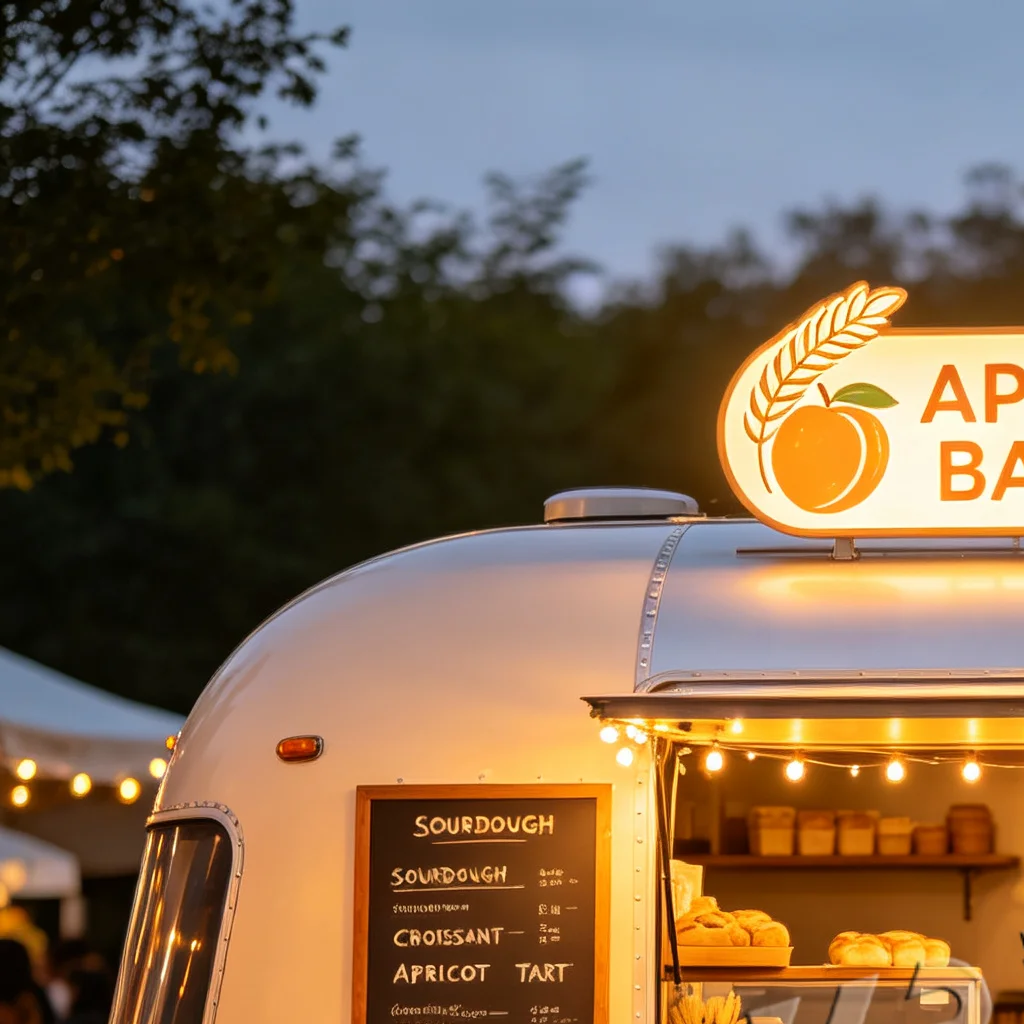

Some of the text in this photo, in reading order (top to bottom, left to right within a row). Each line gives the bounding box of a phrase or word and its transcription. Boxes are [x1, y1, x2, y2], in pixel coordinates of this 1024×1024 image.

[413, 814, 554, 837] SOURDOUGH
[390, 865, 508, 886] SOURDOUGH
[393, 927, 504, 947] CROISSANT
[393, 963, 574, 984] APRICOT TART
